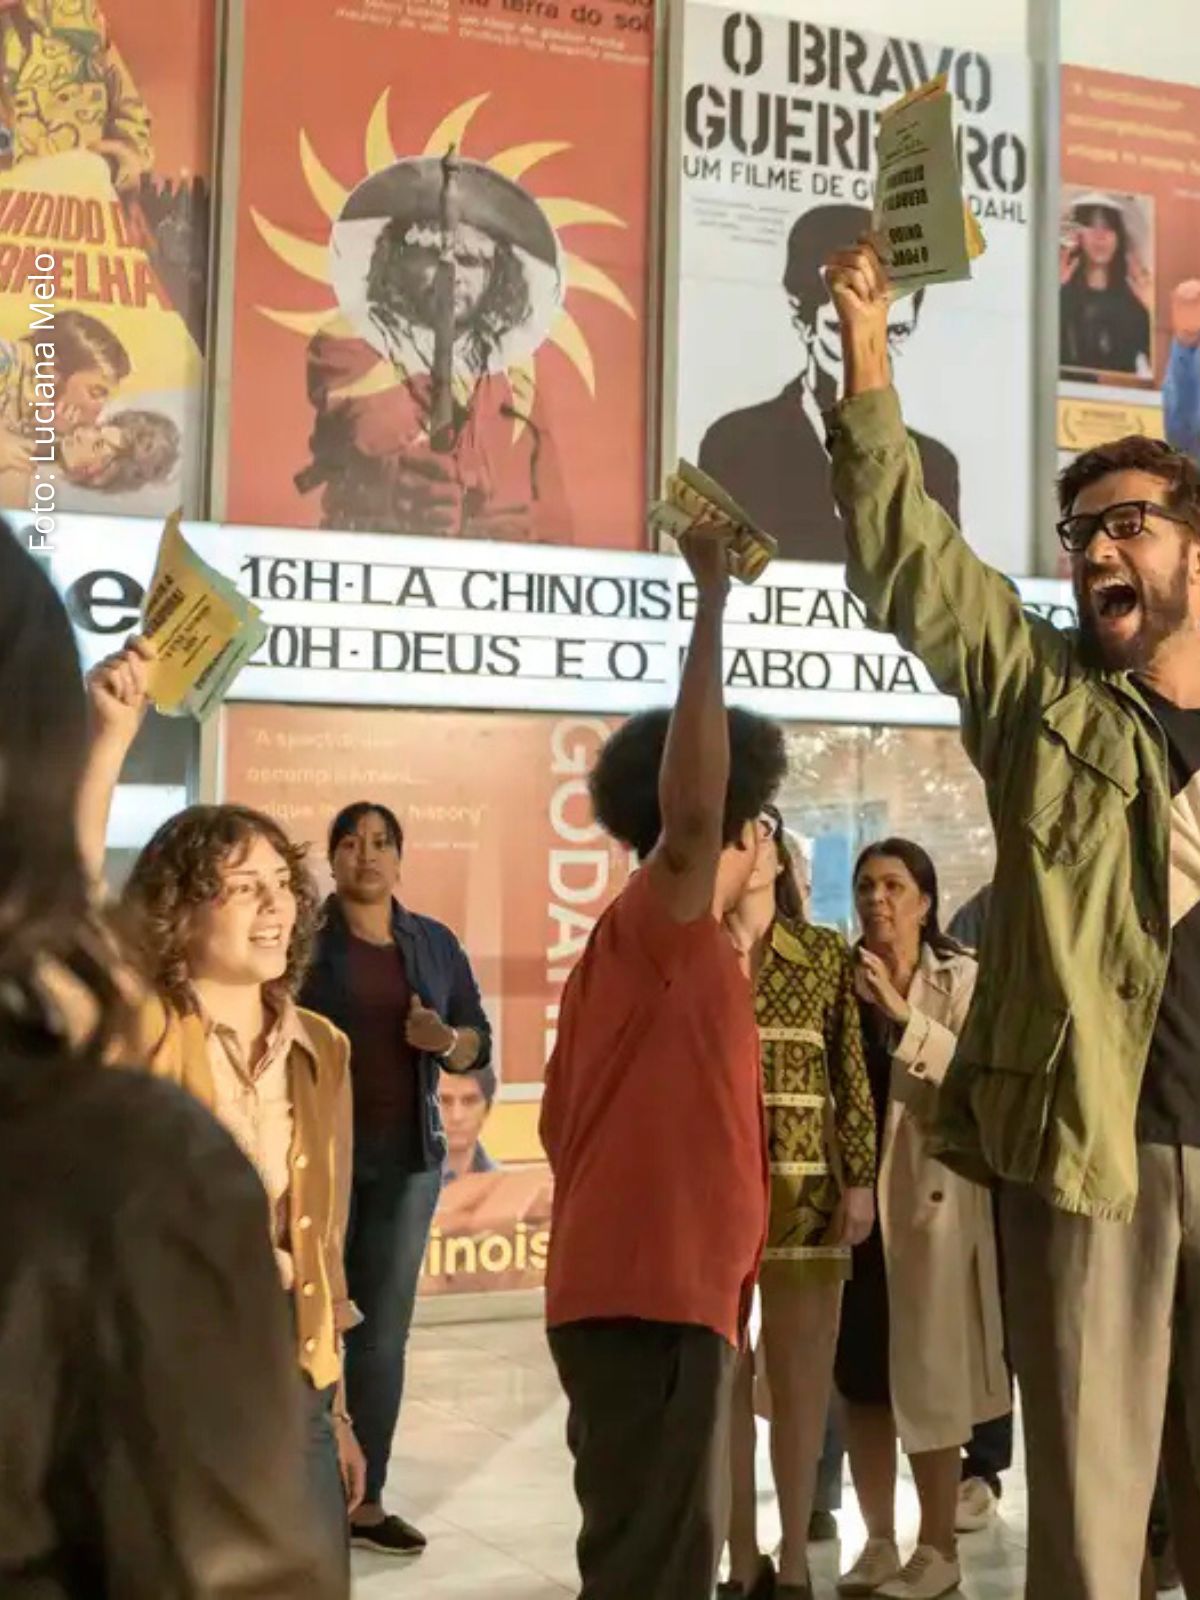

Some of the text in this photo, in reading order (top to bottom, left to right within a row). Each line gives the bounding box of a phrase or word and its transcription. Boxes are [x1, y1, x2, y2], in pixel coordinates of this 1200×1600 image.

[571, 4, 602, 26] do
[722, 12, 992, 115] O BRAVO
[684, 83, 1028, 195] GUERRO
[683, 155, 722, 183] UM
[731, 161, 803, 193] FILME
[811, 173, 845, 199] DE
[968, 193, 1027, 225] DAHL
[461, 569, 698, 622] CHINOISE
[556, 637, 586, 680] E
[608, 640, 649, 682] O
[679, 645, 832, 690] ABO
[854, 652, 920, 694] NA
[545, 715, 612, 1065] GODA
